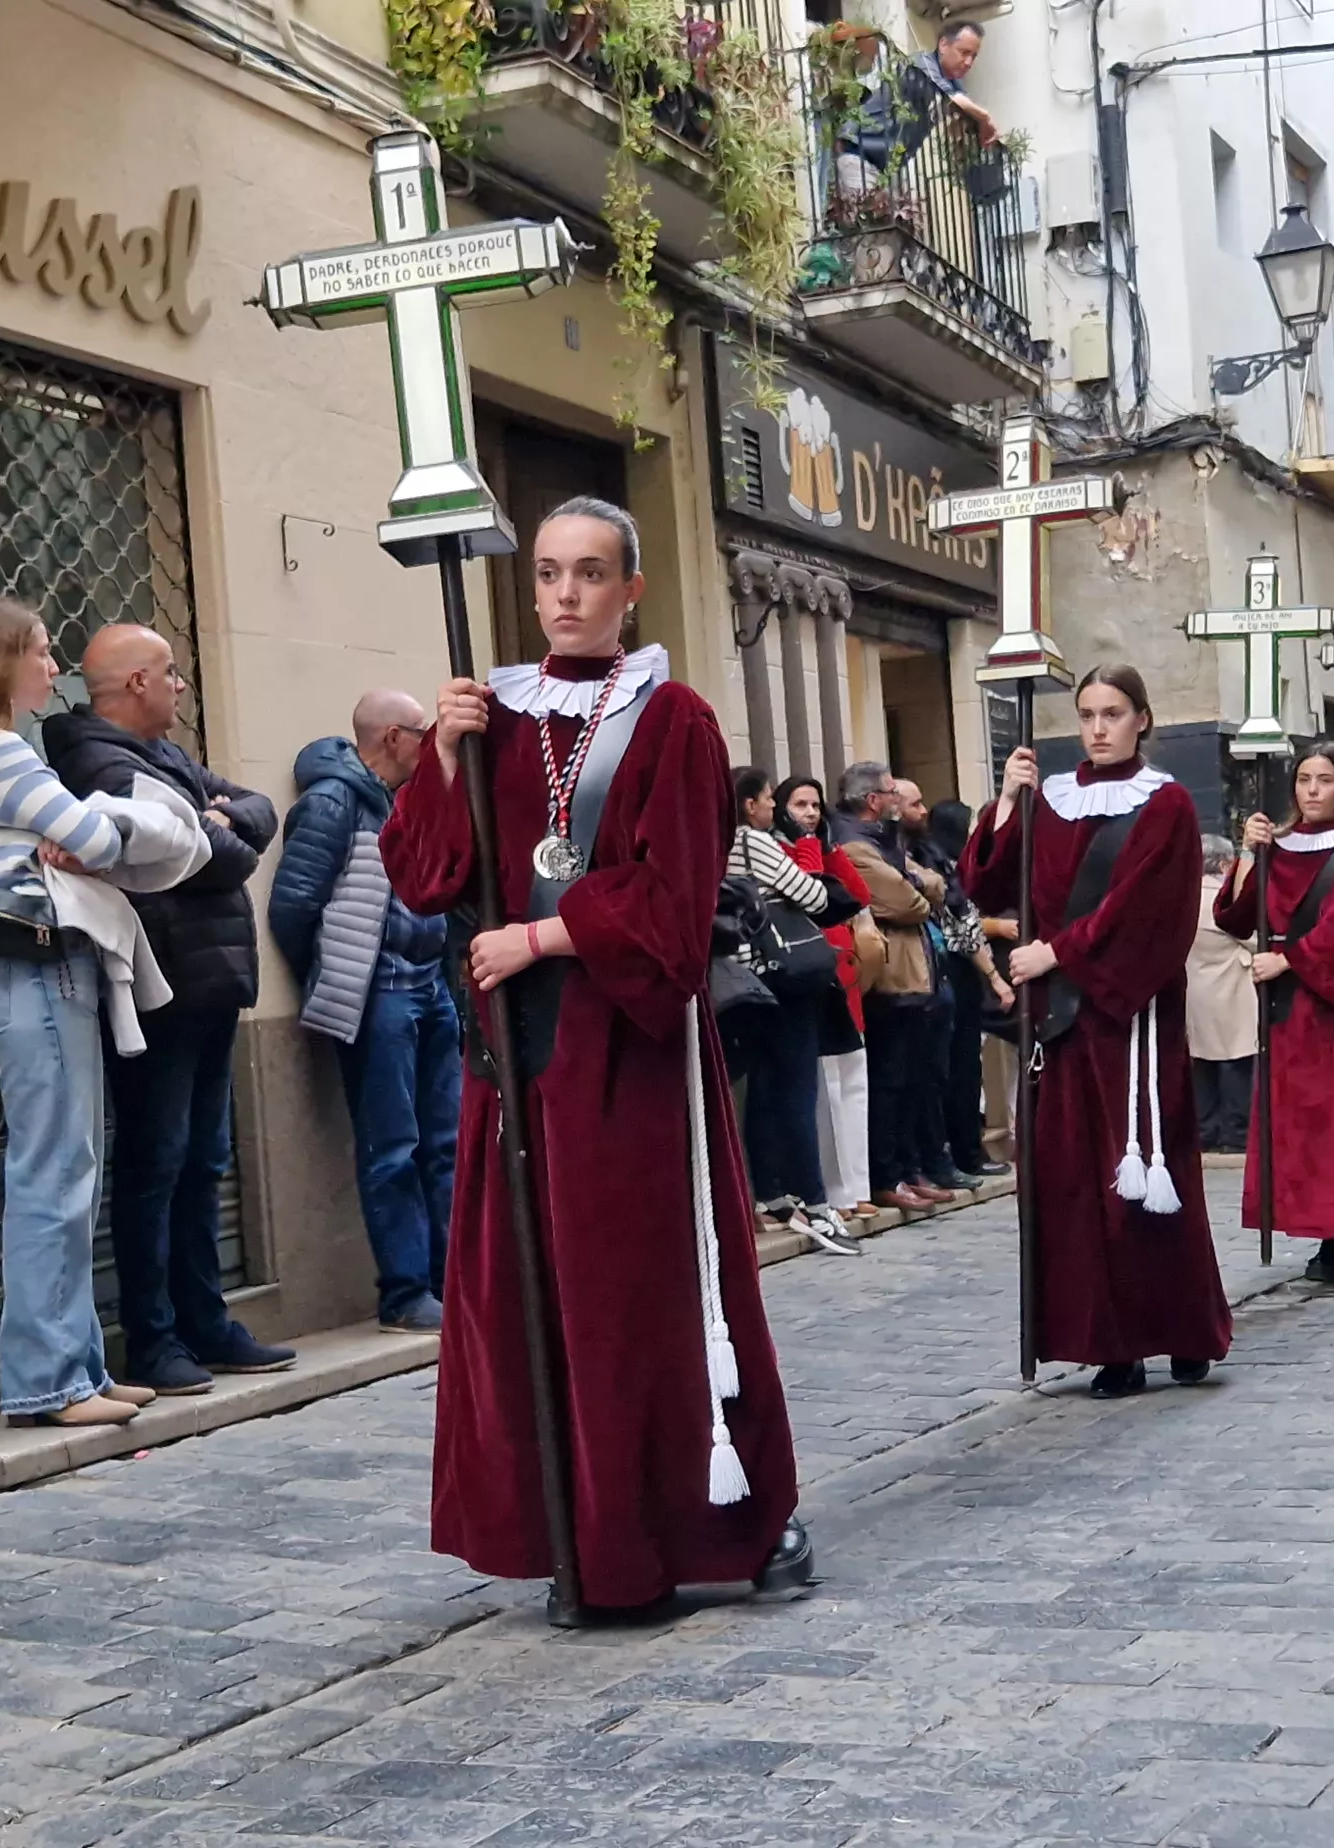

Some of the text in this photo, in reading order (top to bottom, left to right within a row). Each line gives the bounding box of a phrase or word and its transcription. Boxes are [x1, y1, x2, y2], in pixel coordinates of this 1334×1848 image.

[308, 233, 513, 282] PADRE, PERDONALES PORQUE
[322, 255, 491, 296] NO SABEN LO QUE HACEN
[952, 499, 964, 512] TE
[967, 498, 990, 510] DIGO
[993, 493, 1012, 505] QUE
[1037, 484, 1083, 500] ESTARAS
[955, 497, 1079, 522] CONMIGO EN EL PARAISO
